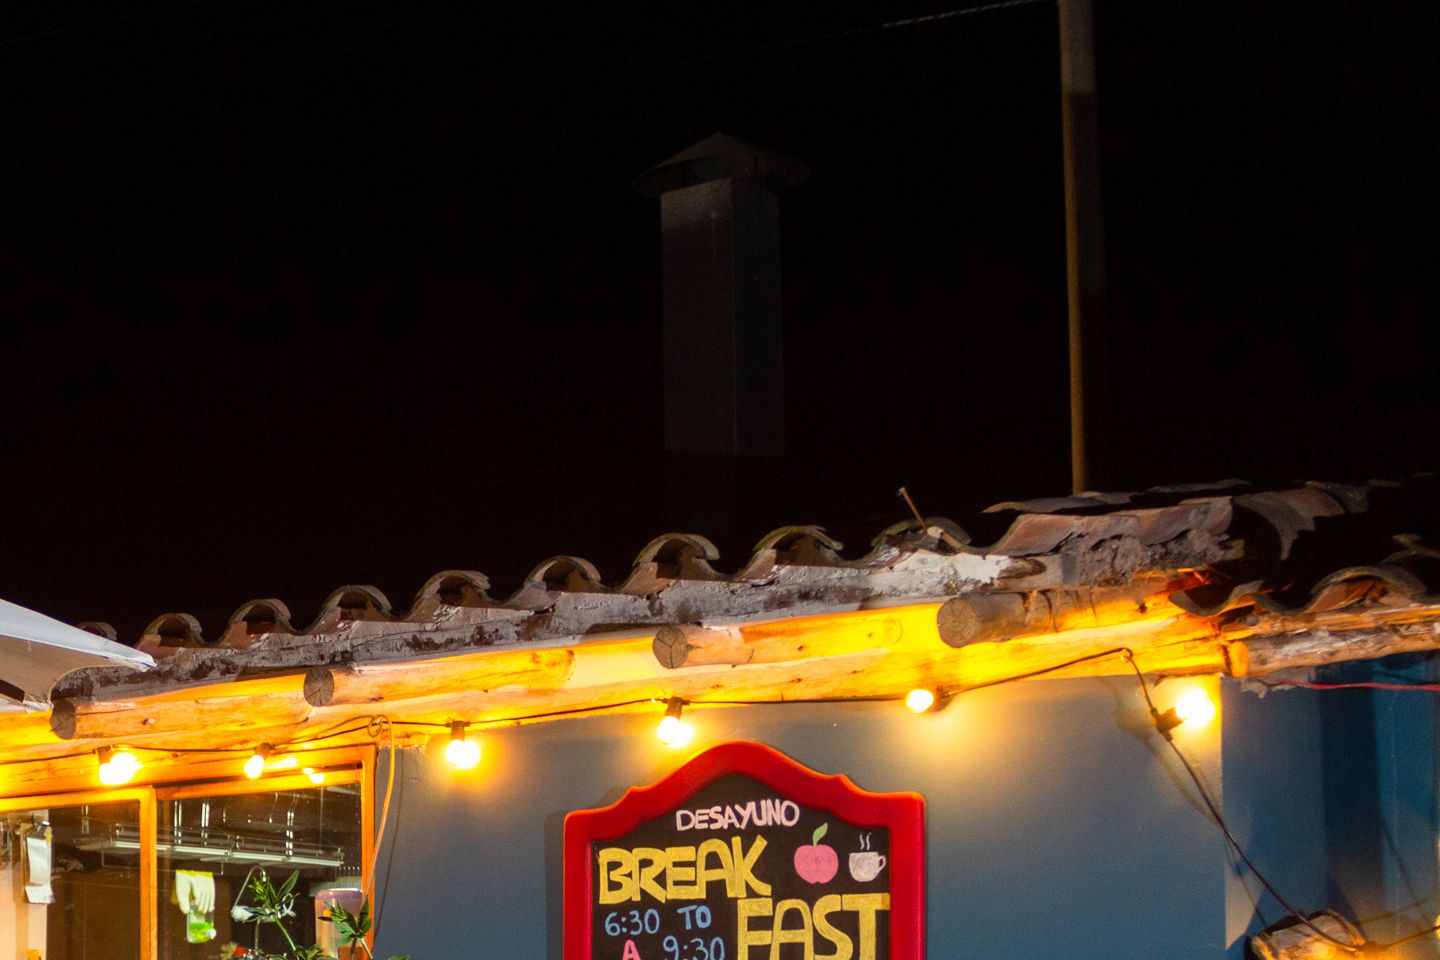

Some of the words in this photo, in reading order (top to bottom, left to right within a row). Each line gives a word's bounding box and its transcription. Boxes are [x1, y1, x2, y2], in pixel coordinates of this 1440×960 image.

[676, 799, 801, 831] DESAYUNO
[598, 835, 772, 904] BREAK
[605, 908, 660, 936] 6:30
[677, 904, 713, 930] TO
